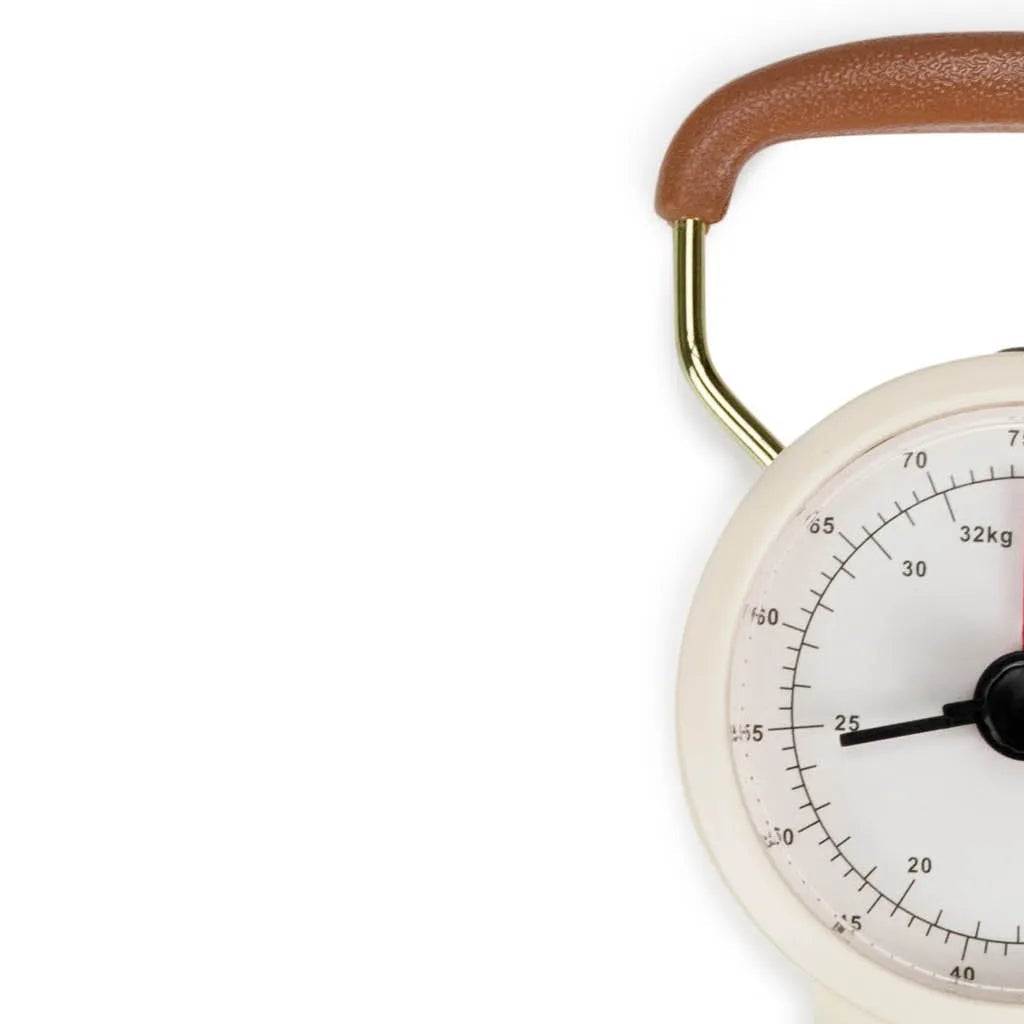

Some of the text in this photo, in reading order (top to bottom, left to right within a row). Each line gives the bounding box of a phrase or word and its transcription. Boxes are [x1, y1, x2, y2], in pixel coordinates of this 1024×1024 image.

[902, 452, 928, 470] 70
[809, 517, 835, 535] 65
[958, 525, 1014, 548] 32kg
[901, 560, 928, 578] 30
[834, 714, 860, 731] 25
[906, 857, 933, 874] 20
[949, 966, 976, 982] 40
